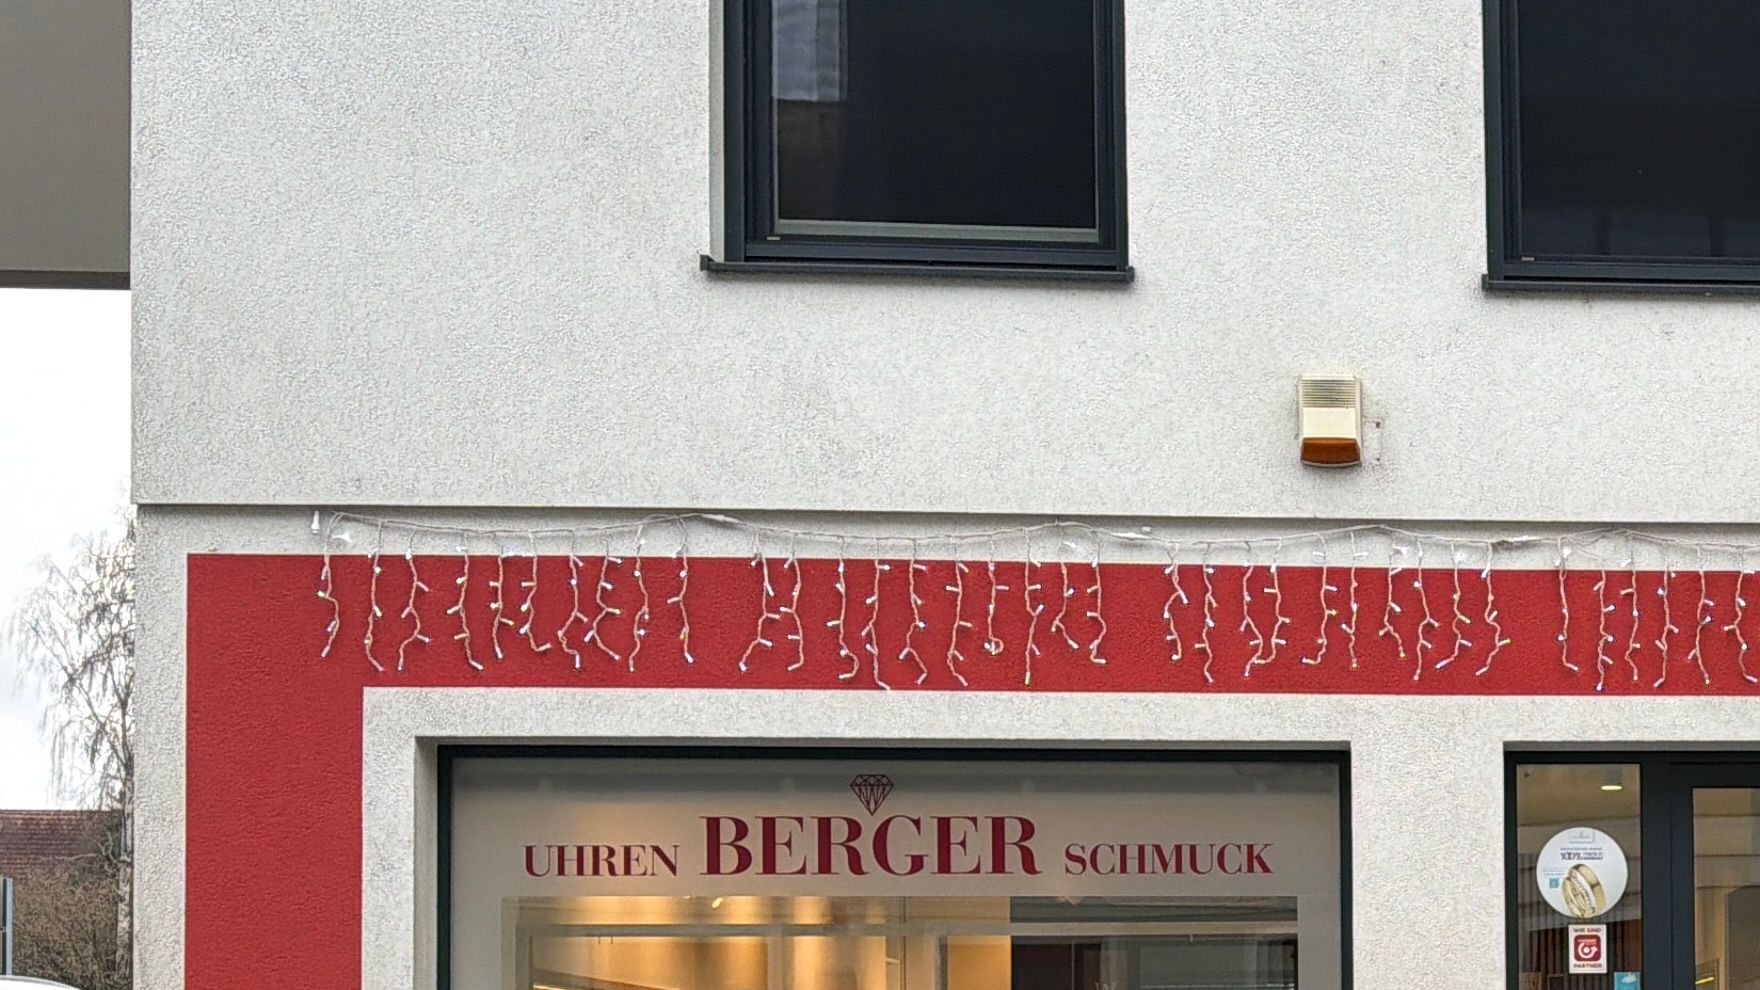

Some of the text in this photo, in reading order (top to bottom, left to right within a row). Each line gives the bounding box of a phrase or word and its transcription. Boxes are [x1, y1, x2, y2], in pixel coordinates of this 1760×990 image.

[521, 815, 1275, 877] UHREN BERGER SCHMUCK
